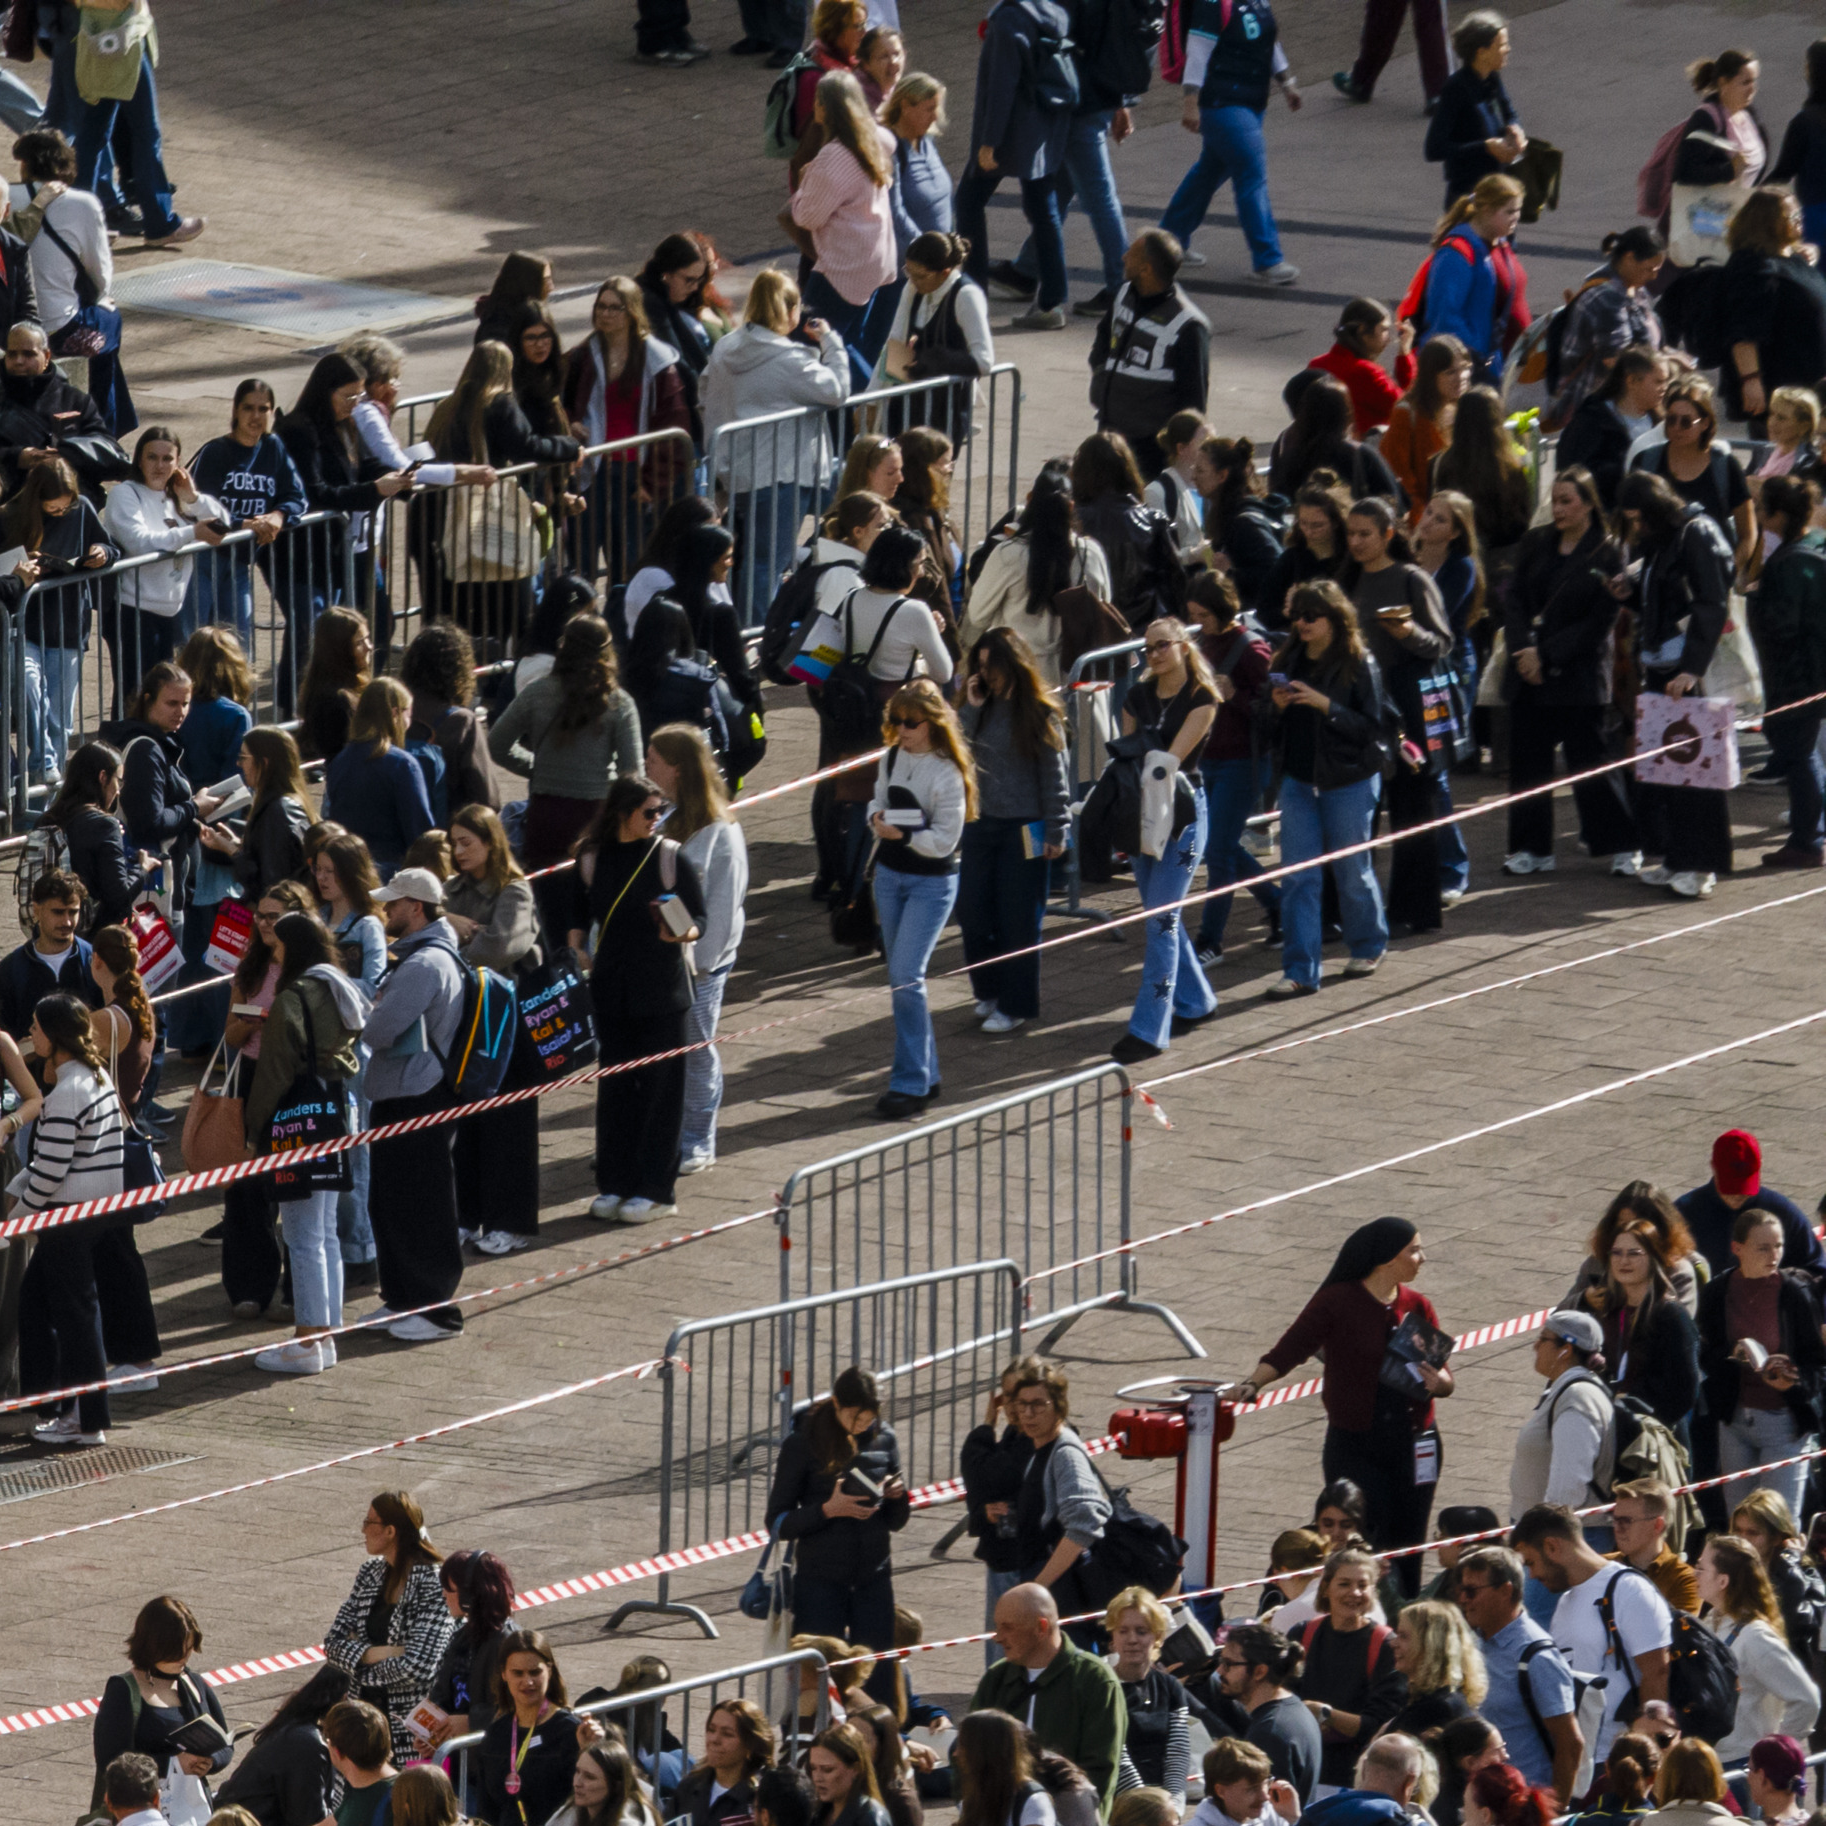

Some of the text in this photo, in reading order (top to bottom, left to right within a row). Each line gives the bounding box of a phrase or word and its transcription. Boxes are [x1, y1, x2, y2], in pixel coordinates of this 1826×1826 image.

[1242, 13, 1261, 40] 6
[519, 973, 578, 1014] Zanders &
[525, 996, 569, 1028] Ryan &
[531, 1017, 565, 1042] Kai &
[273, 1101, 336, 1122] Zanders &
[272, 1118, 316, 1138] Ryan &
[271, 1137, 292, 1153] Kai
